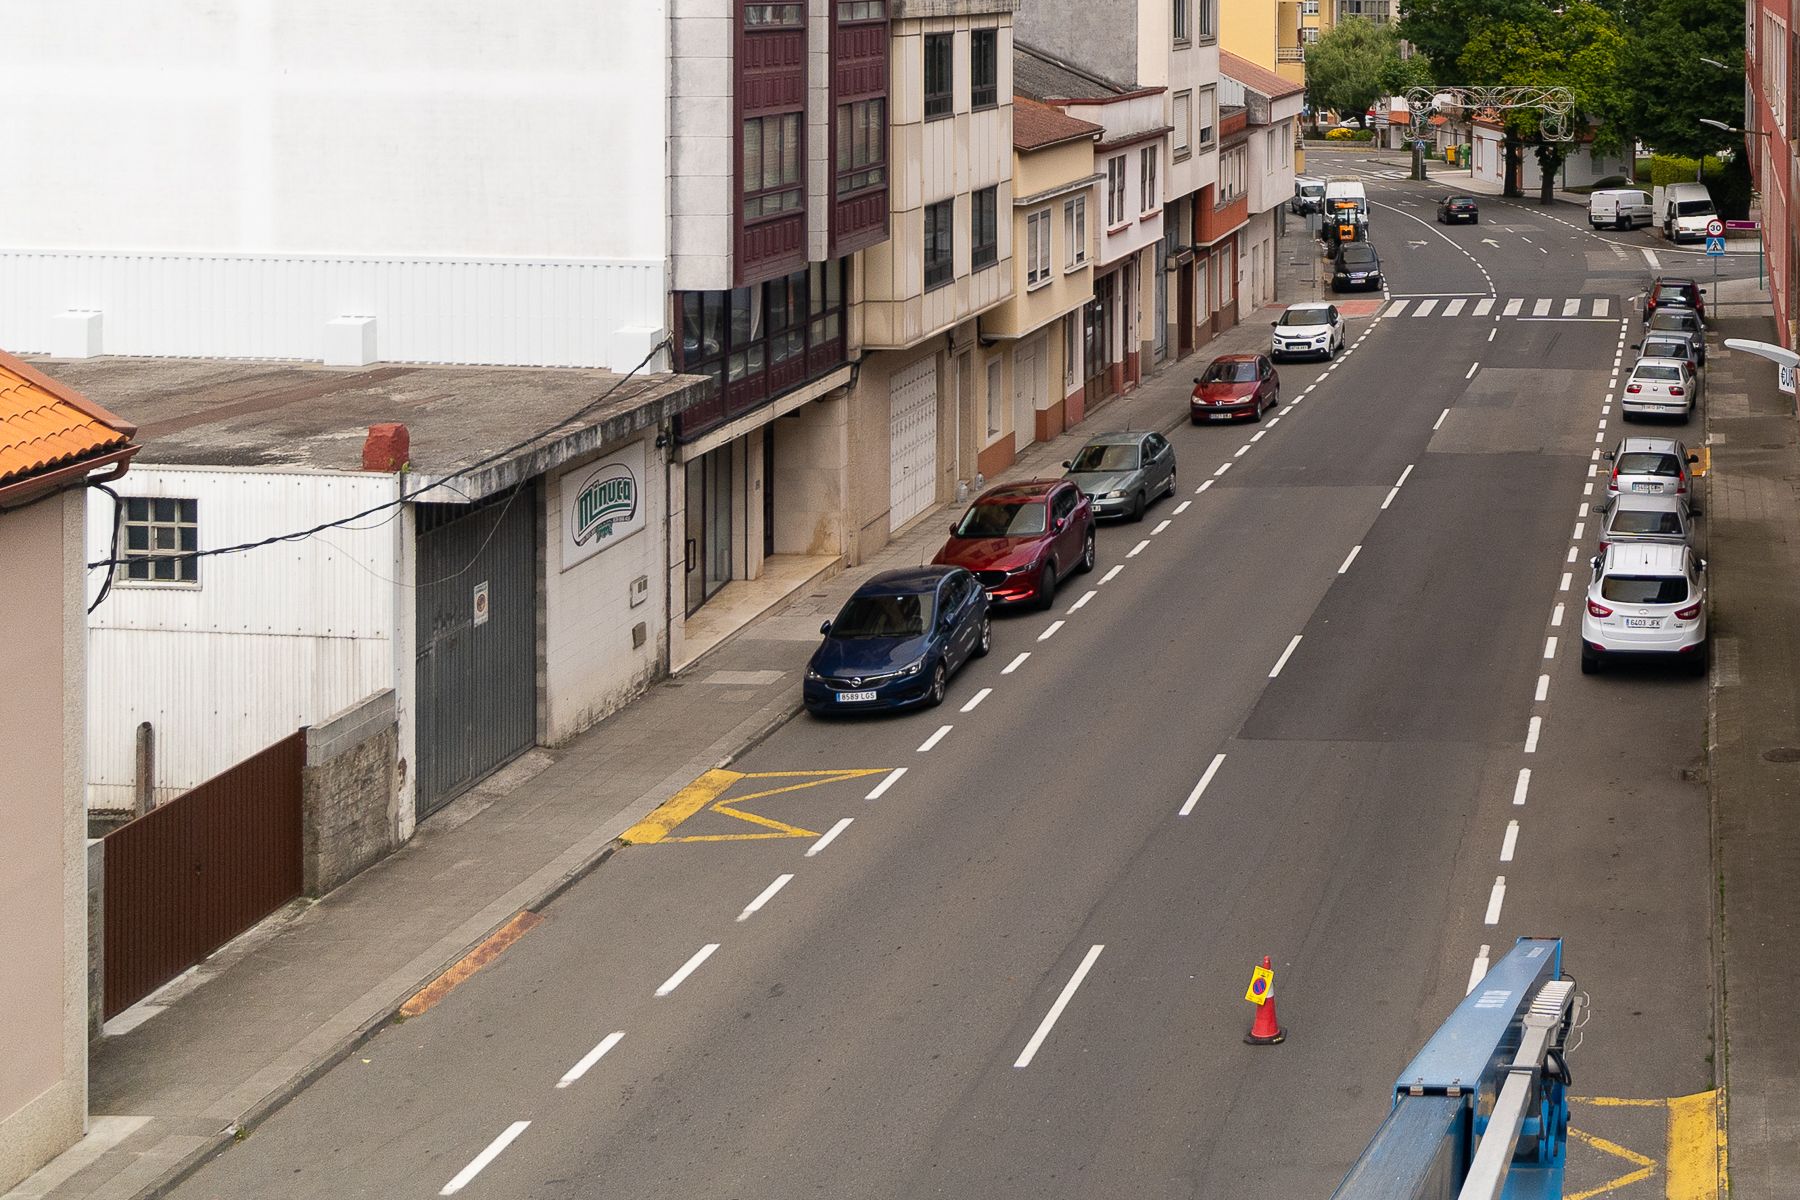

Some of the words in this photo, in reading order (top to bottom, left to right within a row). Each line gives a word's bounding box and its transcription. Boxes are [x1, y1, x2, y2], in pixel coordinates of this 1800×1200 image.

[1710, 224, 1722, 232] 30
[1630, 619, 1647, 627] 6403
[1648, 619, 1661, 627] JFK
[841, 693, 859, 701] 8589
[860, 692, 875, 700] LGS
